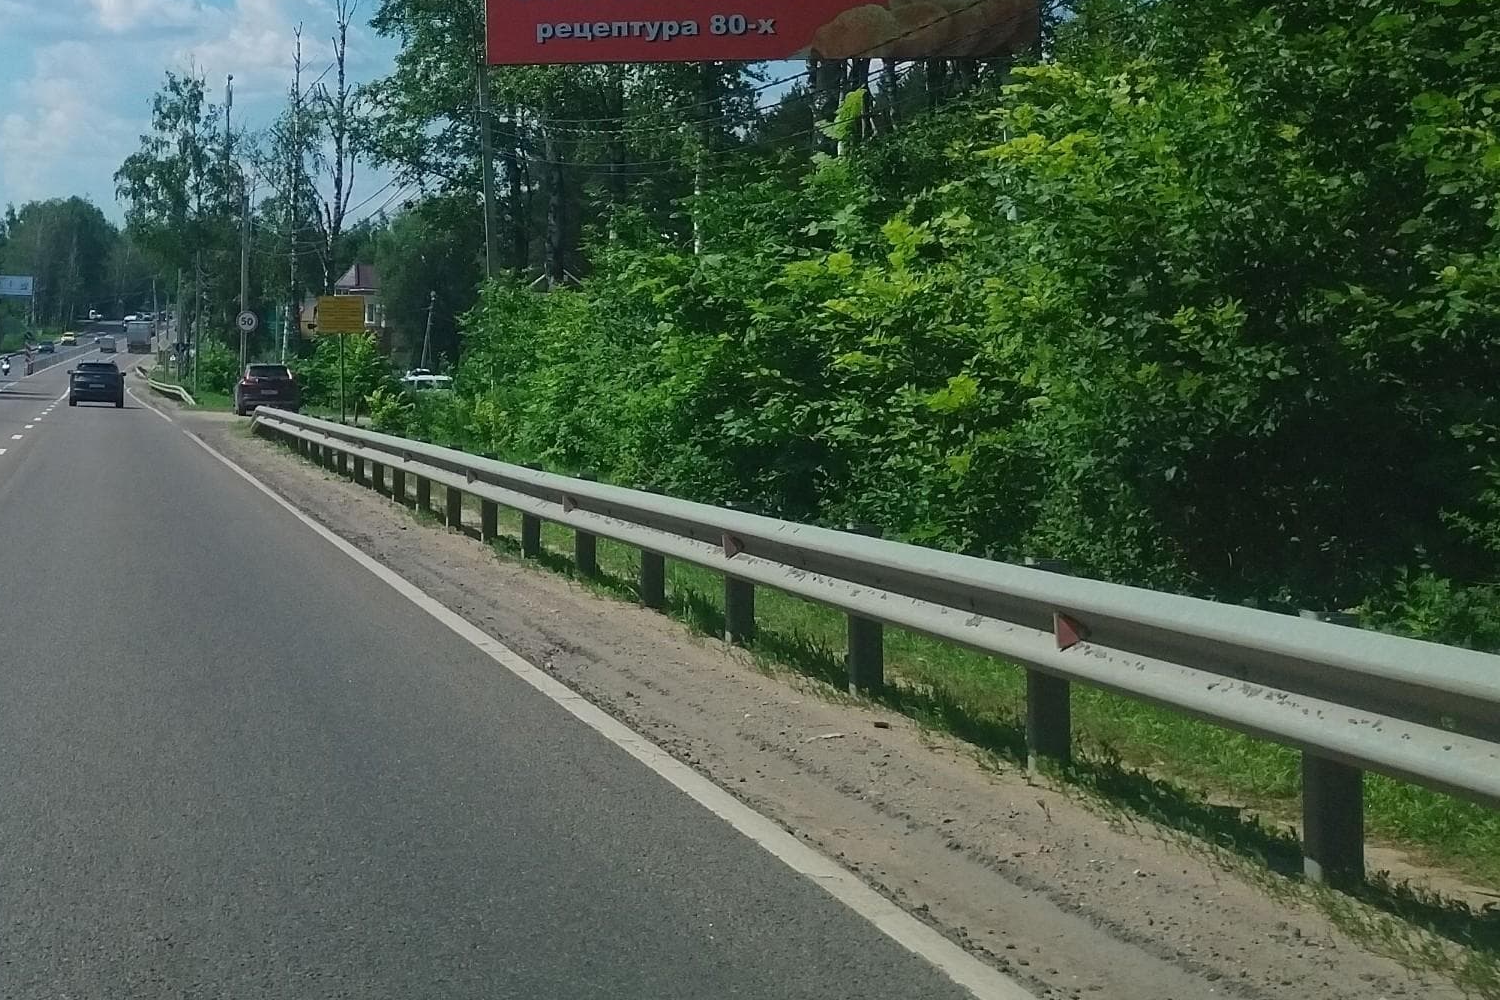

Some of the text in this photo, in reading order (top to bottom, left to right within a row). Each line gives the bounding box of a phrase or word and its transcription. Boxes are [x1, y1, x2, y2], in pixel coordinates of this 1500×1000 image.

[536, 14, 775, 42] рецептура 80-х
[241, 316, 253, 326] 50
